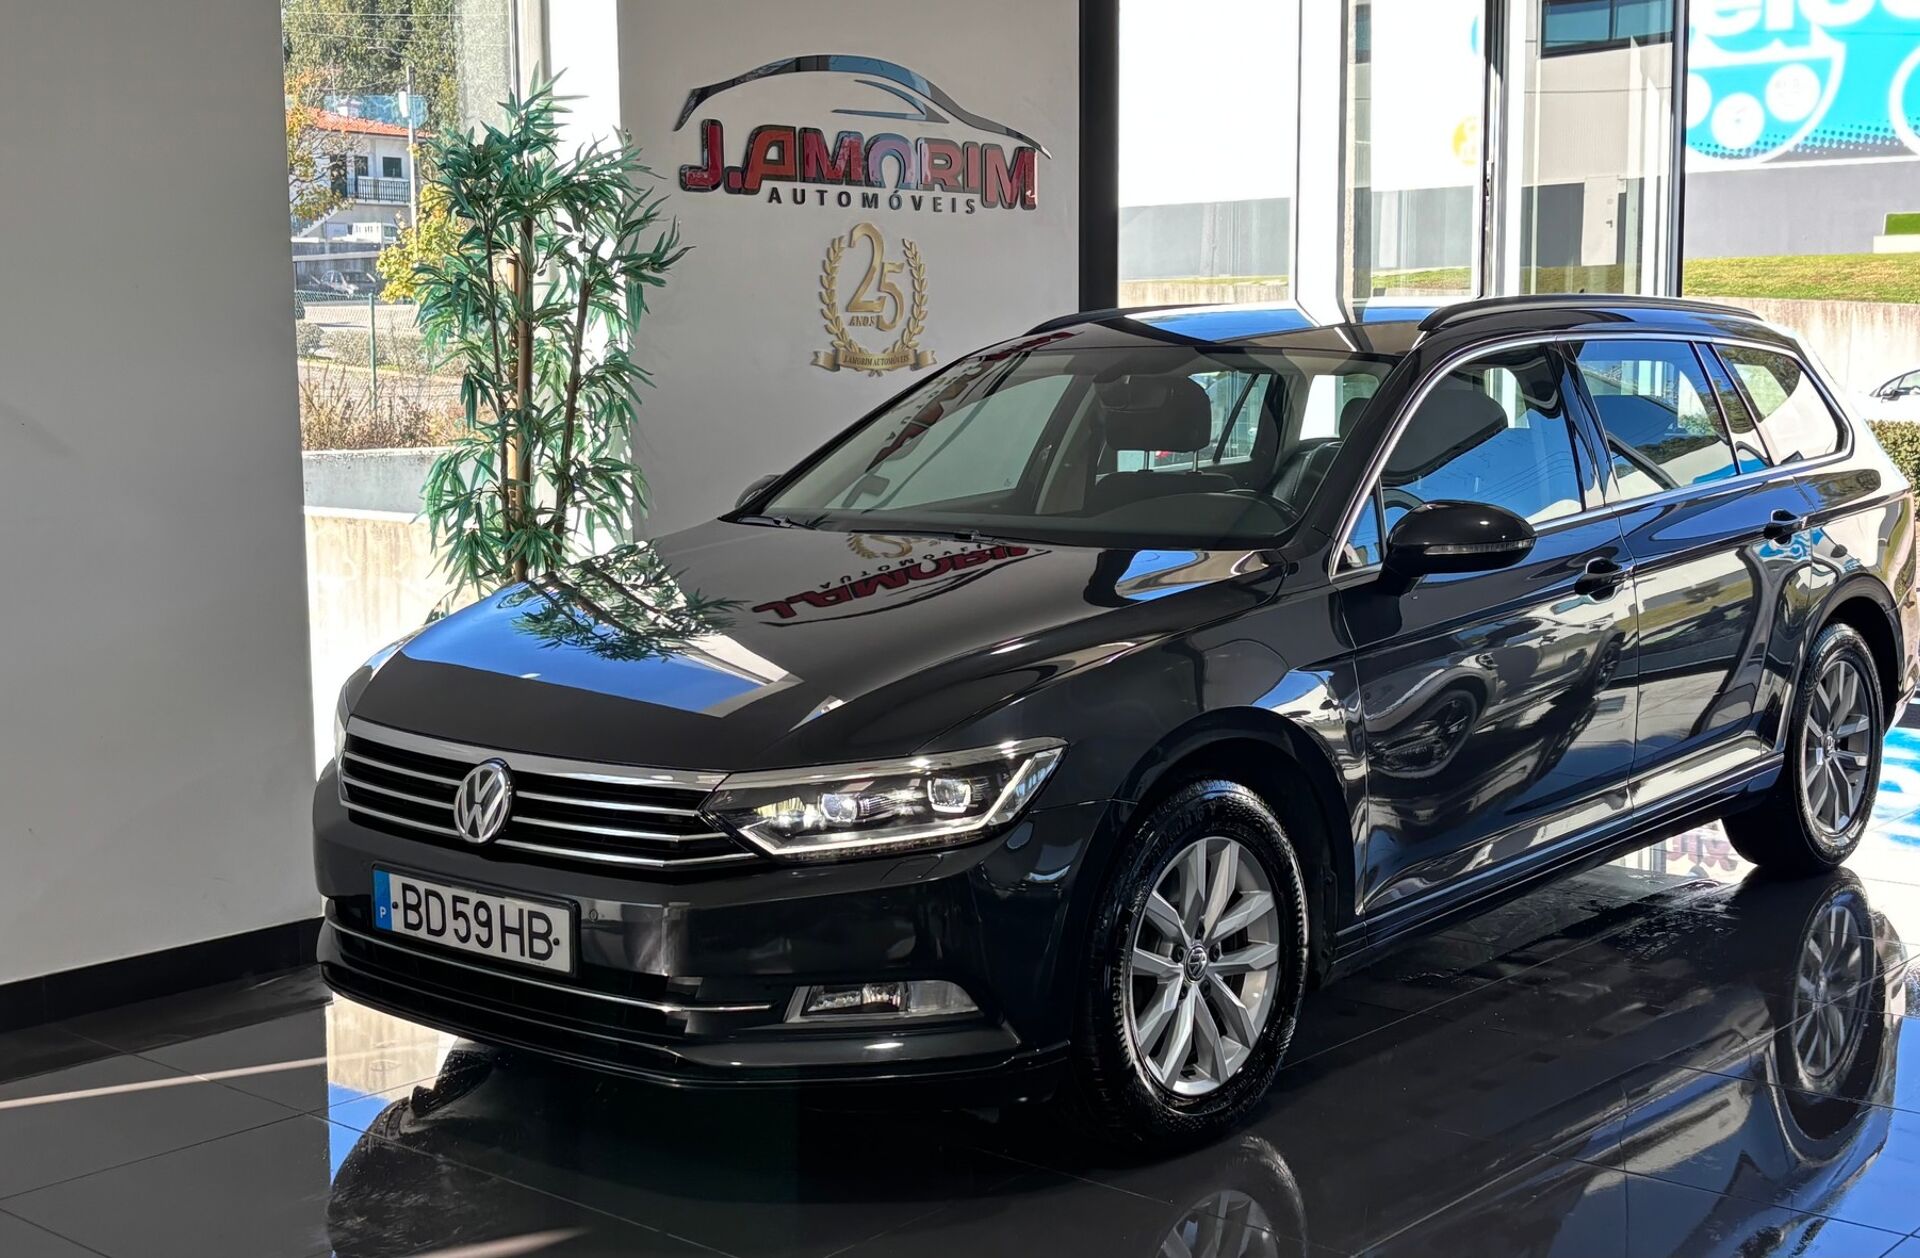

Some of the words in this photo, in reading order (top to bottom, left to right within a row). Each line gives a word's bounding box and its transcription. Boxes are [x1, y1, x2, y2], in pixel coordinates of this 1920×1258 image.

[678, 119, 1039, 210] J.AMORIM
[767, 186, 976, 214] AUTOMÓVEIS
[847, 222, 905, 332] 25
[379, 907, 387, 918] P
